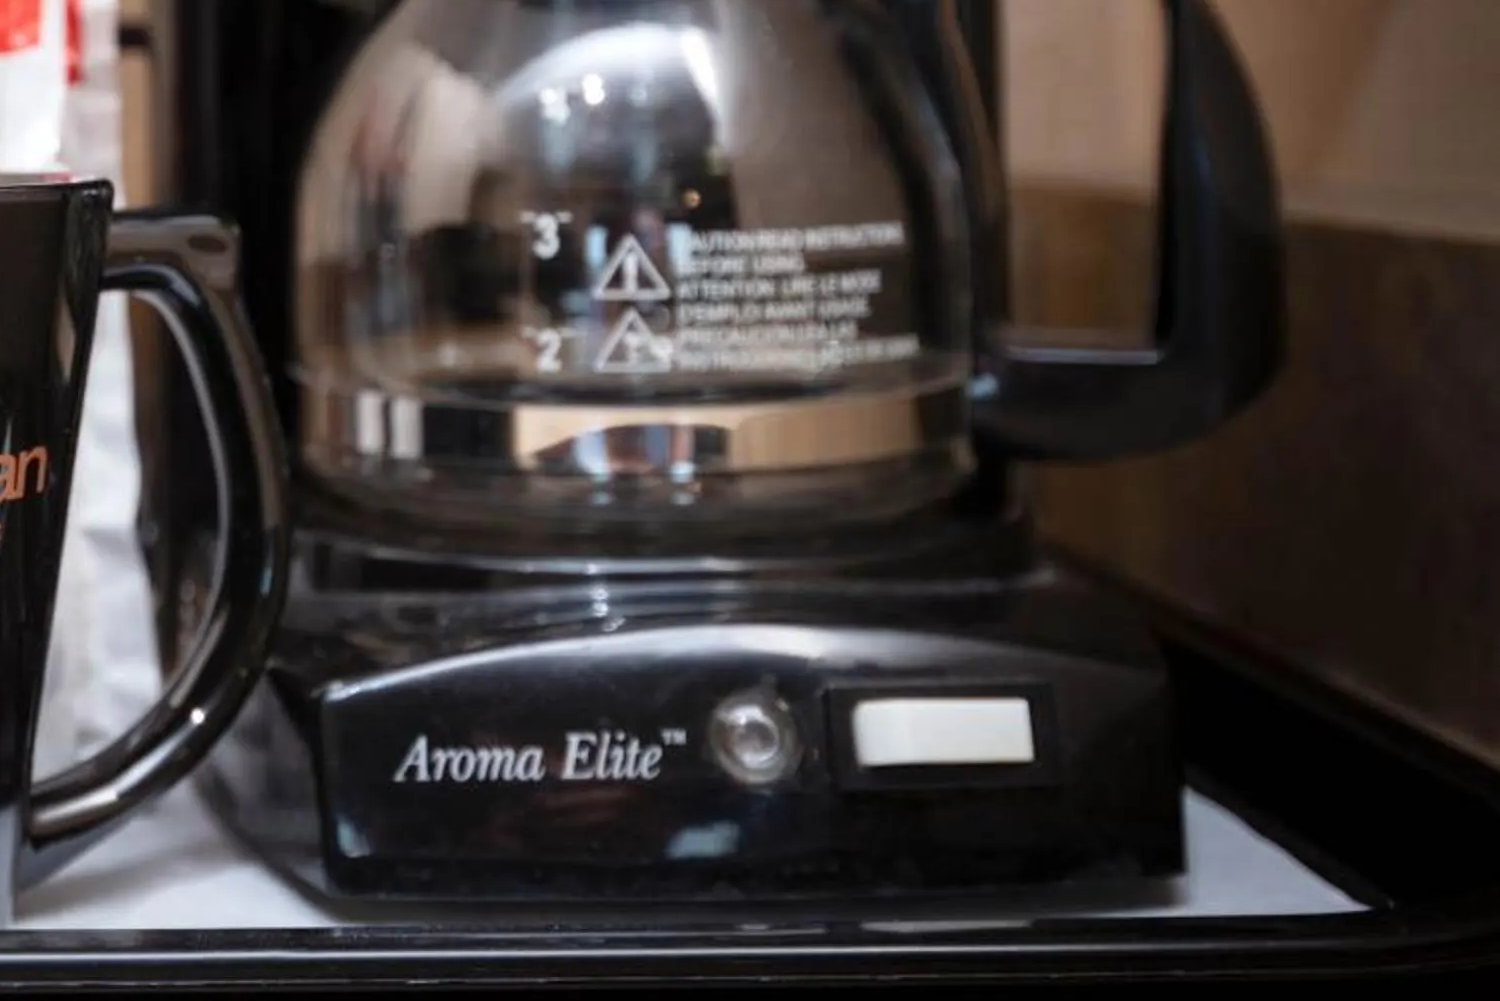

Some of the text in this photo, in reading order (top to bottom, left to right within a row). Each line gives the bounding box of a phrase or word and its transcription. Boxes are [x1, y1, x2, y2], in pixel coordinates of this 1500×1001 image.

[531, 211, 562, 260] 3
[680, 229, 753, 251] AUTION
[535, 329, 563, 373] 2
[392, 733, 547, 783] Aroma
